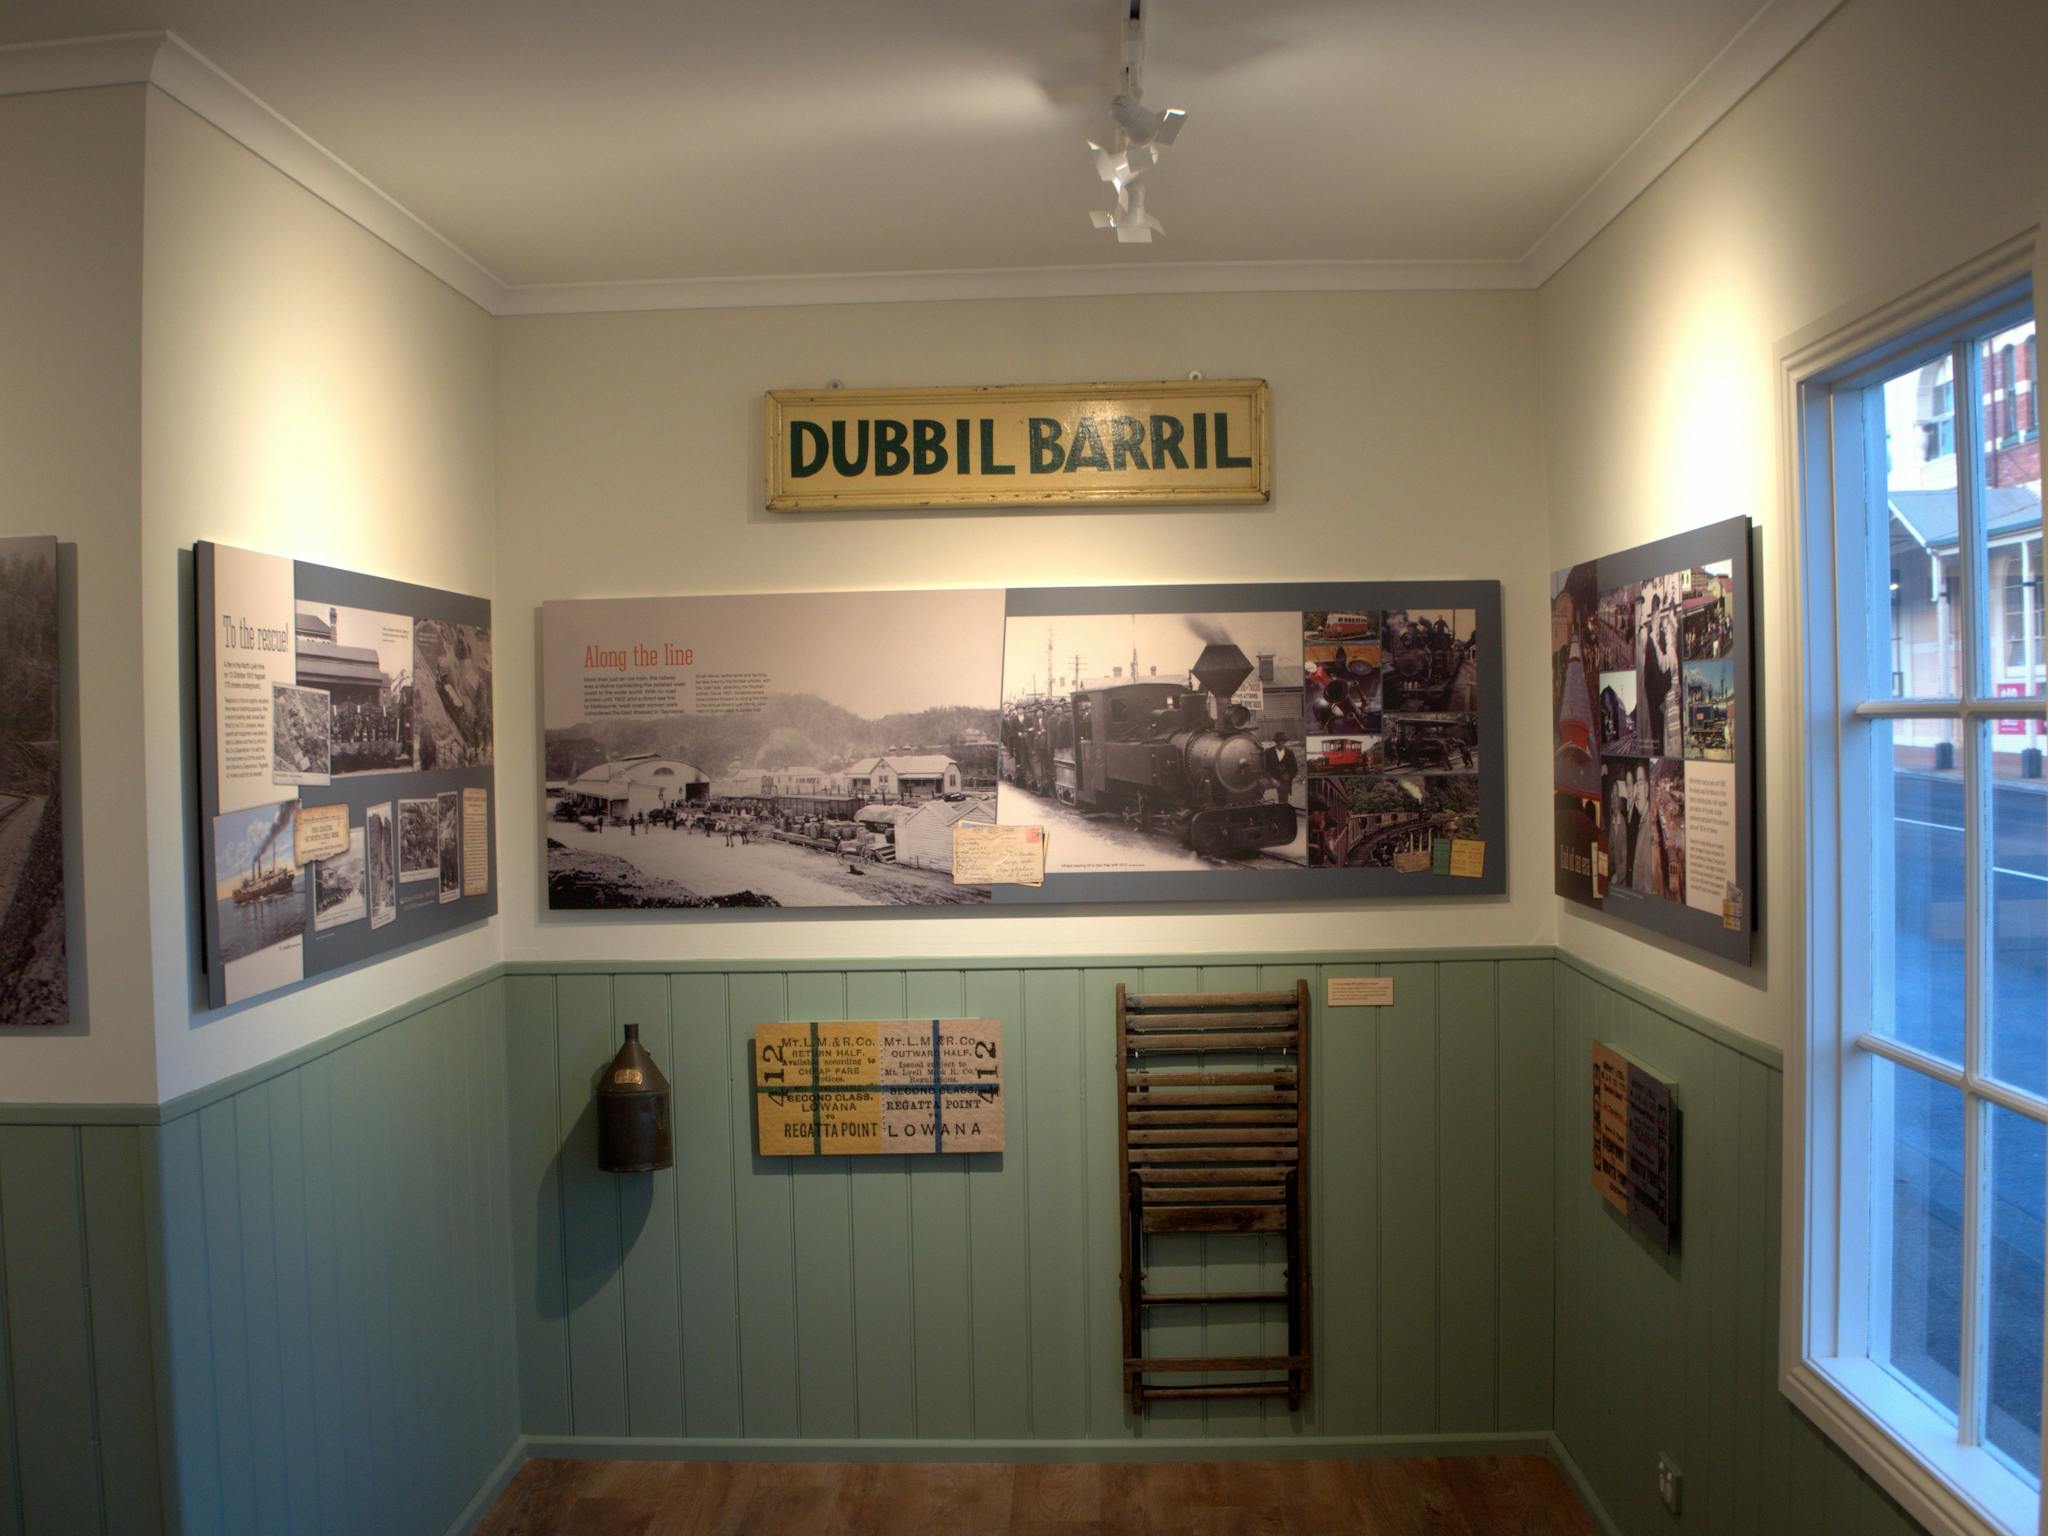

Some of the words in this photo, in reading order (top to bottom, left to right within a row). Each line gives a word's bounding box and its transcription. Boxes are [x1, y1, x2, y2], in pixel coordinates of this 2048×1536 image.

[790, 417, 1016, 479] DUBBIL
[1028, 412, 1253, 475] BARRIL
[222, 614, 237, 649] To
[239, 616, 255, 651] the
[257, 623, 290, 654] rescue!
[584, 644, 627, 671] Along
[633, 643, 658, 667] the
[664, 642, 694, 667] line
[891, 1050, 940, 1058] OUTWARD
[802, 1102, 856, 1112] LOWANA
[886, 1100, 940, 1110] REGATTA
[946, 1100, 981, 1109] POINT
[785, 1123, 838, 1137] REGATTA
[842, 1123, 878, 1137] POINT
[888, 1123, 981, 1137] LOWANA
